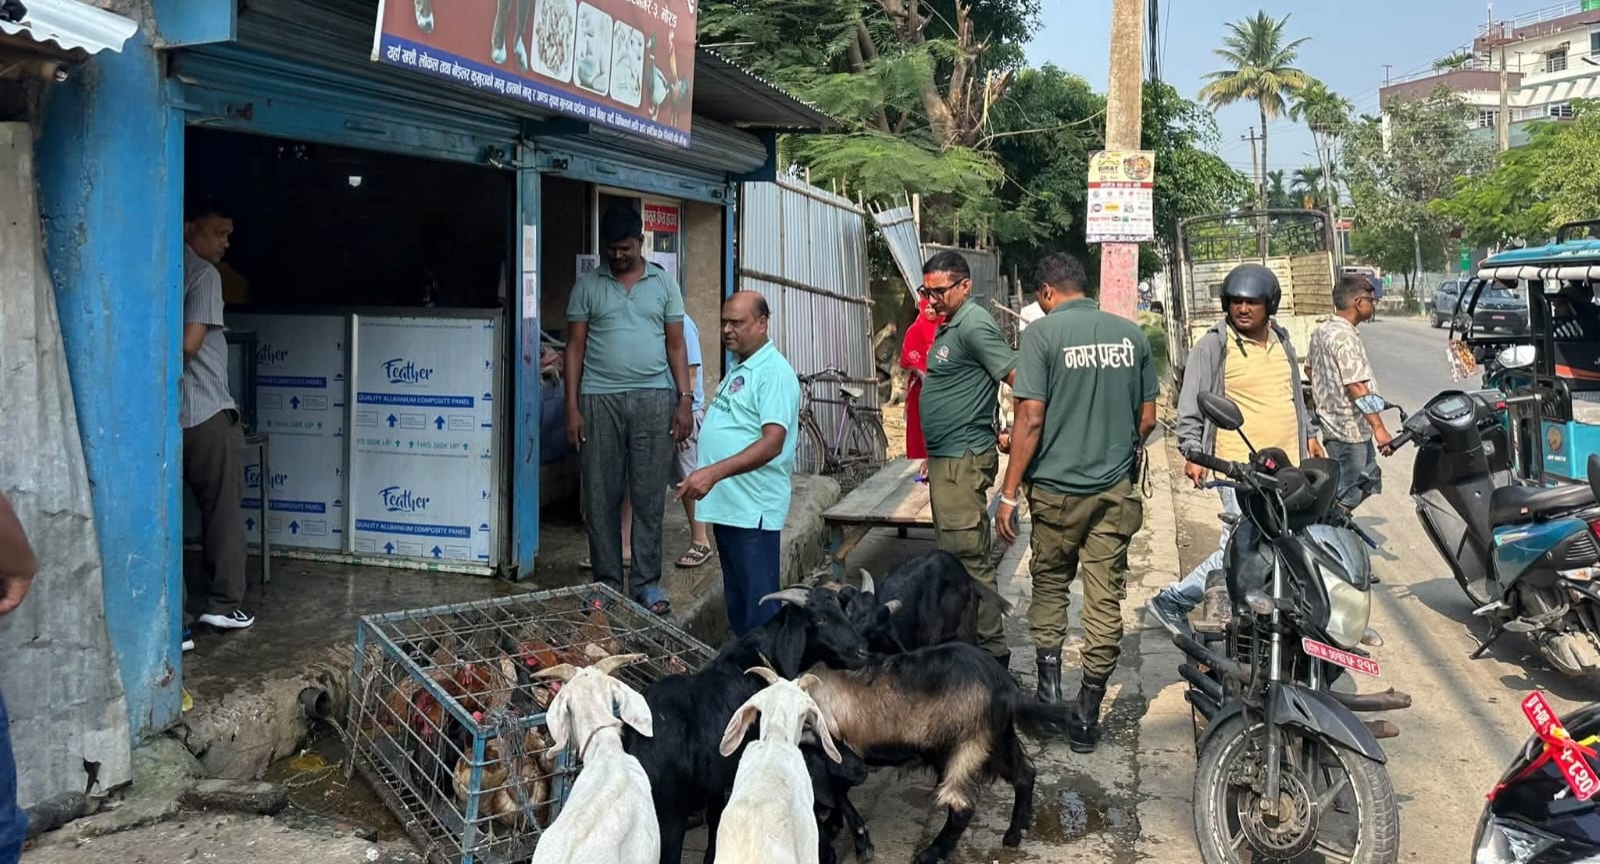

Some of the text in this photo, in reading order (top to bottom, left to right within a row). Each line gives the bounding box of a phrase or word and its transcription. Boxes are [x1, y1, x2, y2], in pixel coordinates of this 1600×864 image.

[418, 51, 439, 71] लोकल
[440, 60, 452, 75] तथा
[255, 341, 288, 365] ather
[1063, 337, 1135, 369] नगर प्रहरी
[381, 358, 433, 384] Feather
[358, 393, 382, 402] QUALITY
[383, 395, 416, 404] ALUMINIUM
[416, 397, 451, 406] COMPOSITE
[366, 438, 381, 446] SIDE
[417, 440, 432, 449] THIS
[433, 441, 448, 450] SIDE
[378, 486, 430, 512] Feather
[356, 520, 379, 530] QUALITY
[380, 522, 413, 532] ALUMINIUM
[414, 525, 447, 535] COMPOSITE
